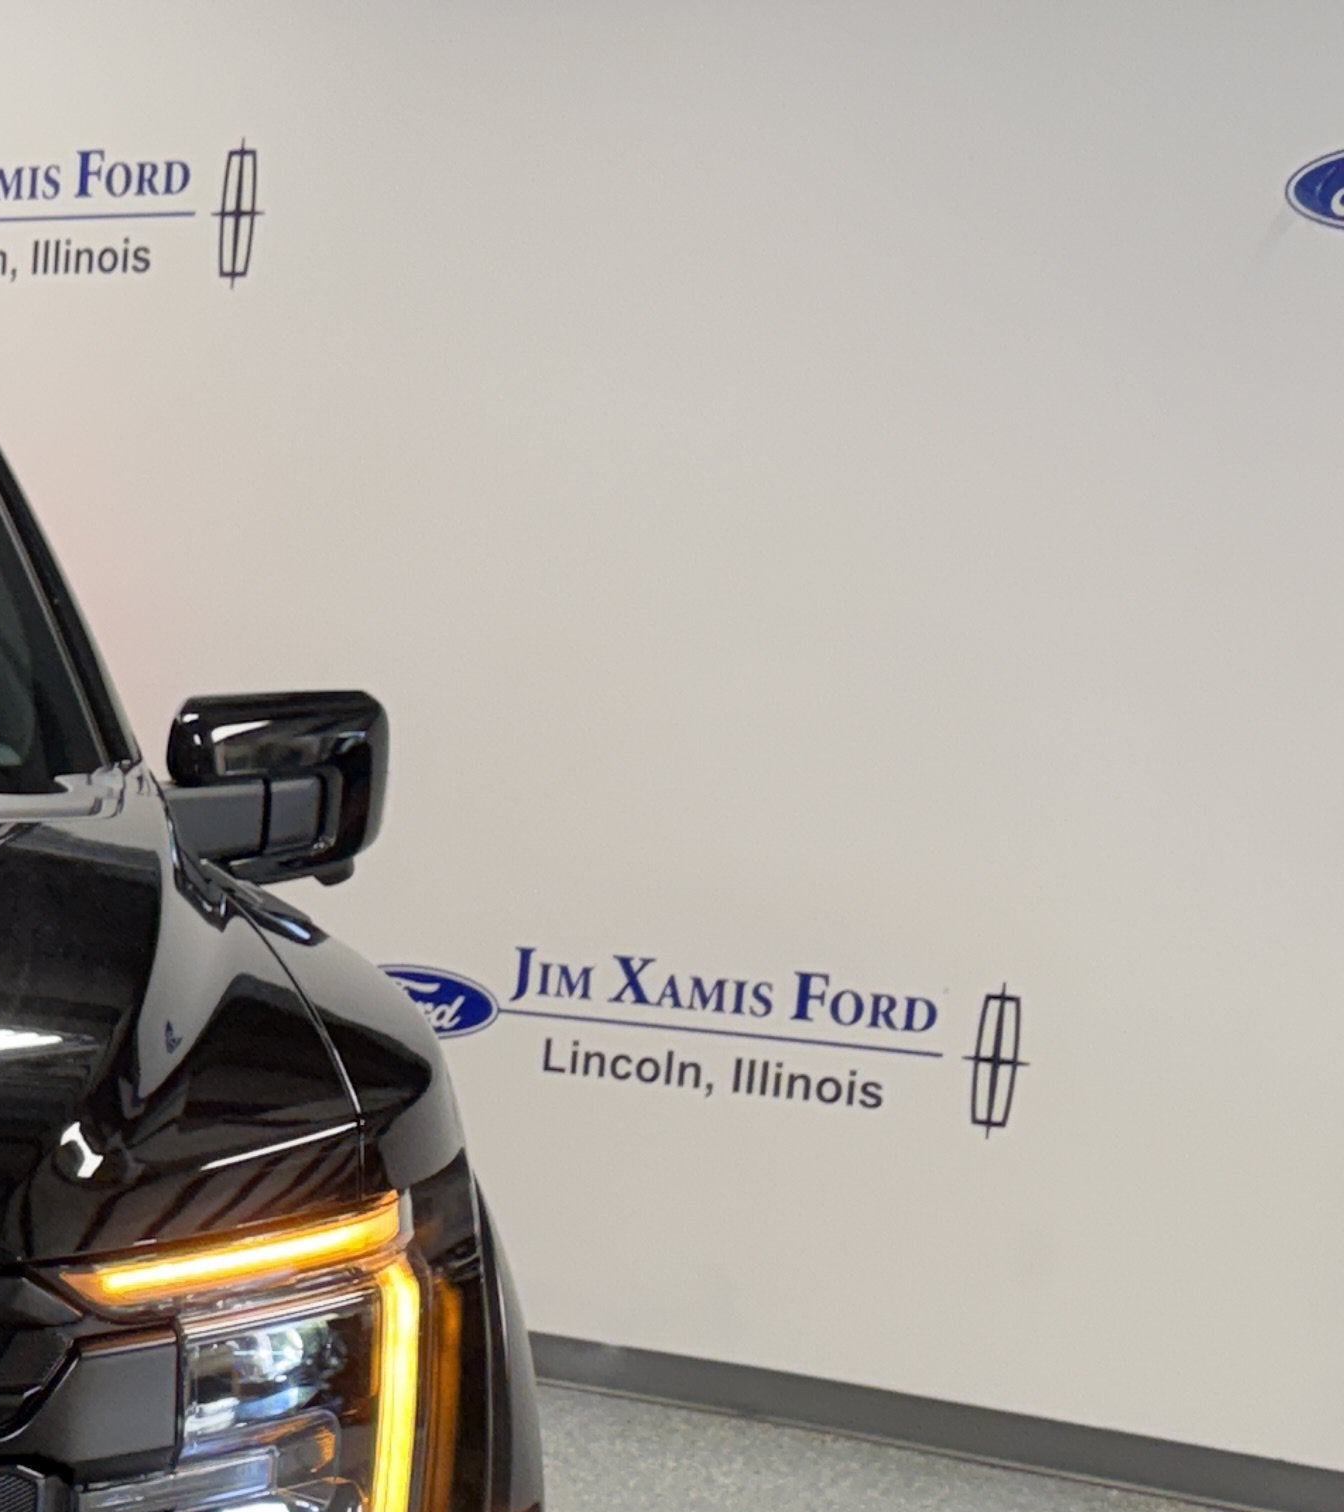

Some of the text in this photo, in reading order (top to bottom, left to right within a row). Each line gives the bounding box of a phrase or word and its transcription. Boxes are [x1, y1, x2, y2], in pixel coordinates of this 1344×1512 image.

[75, 149, 190, 197] FORD
[31, 237, 151, 275] Illinois
[510, 946, 939, 1032] JIM XAMIS FORD
[542, 1037, 884, 1109] Lincoln, Illinois
